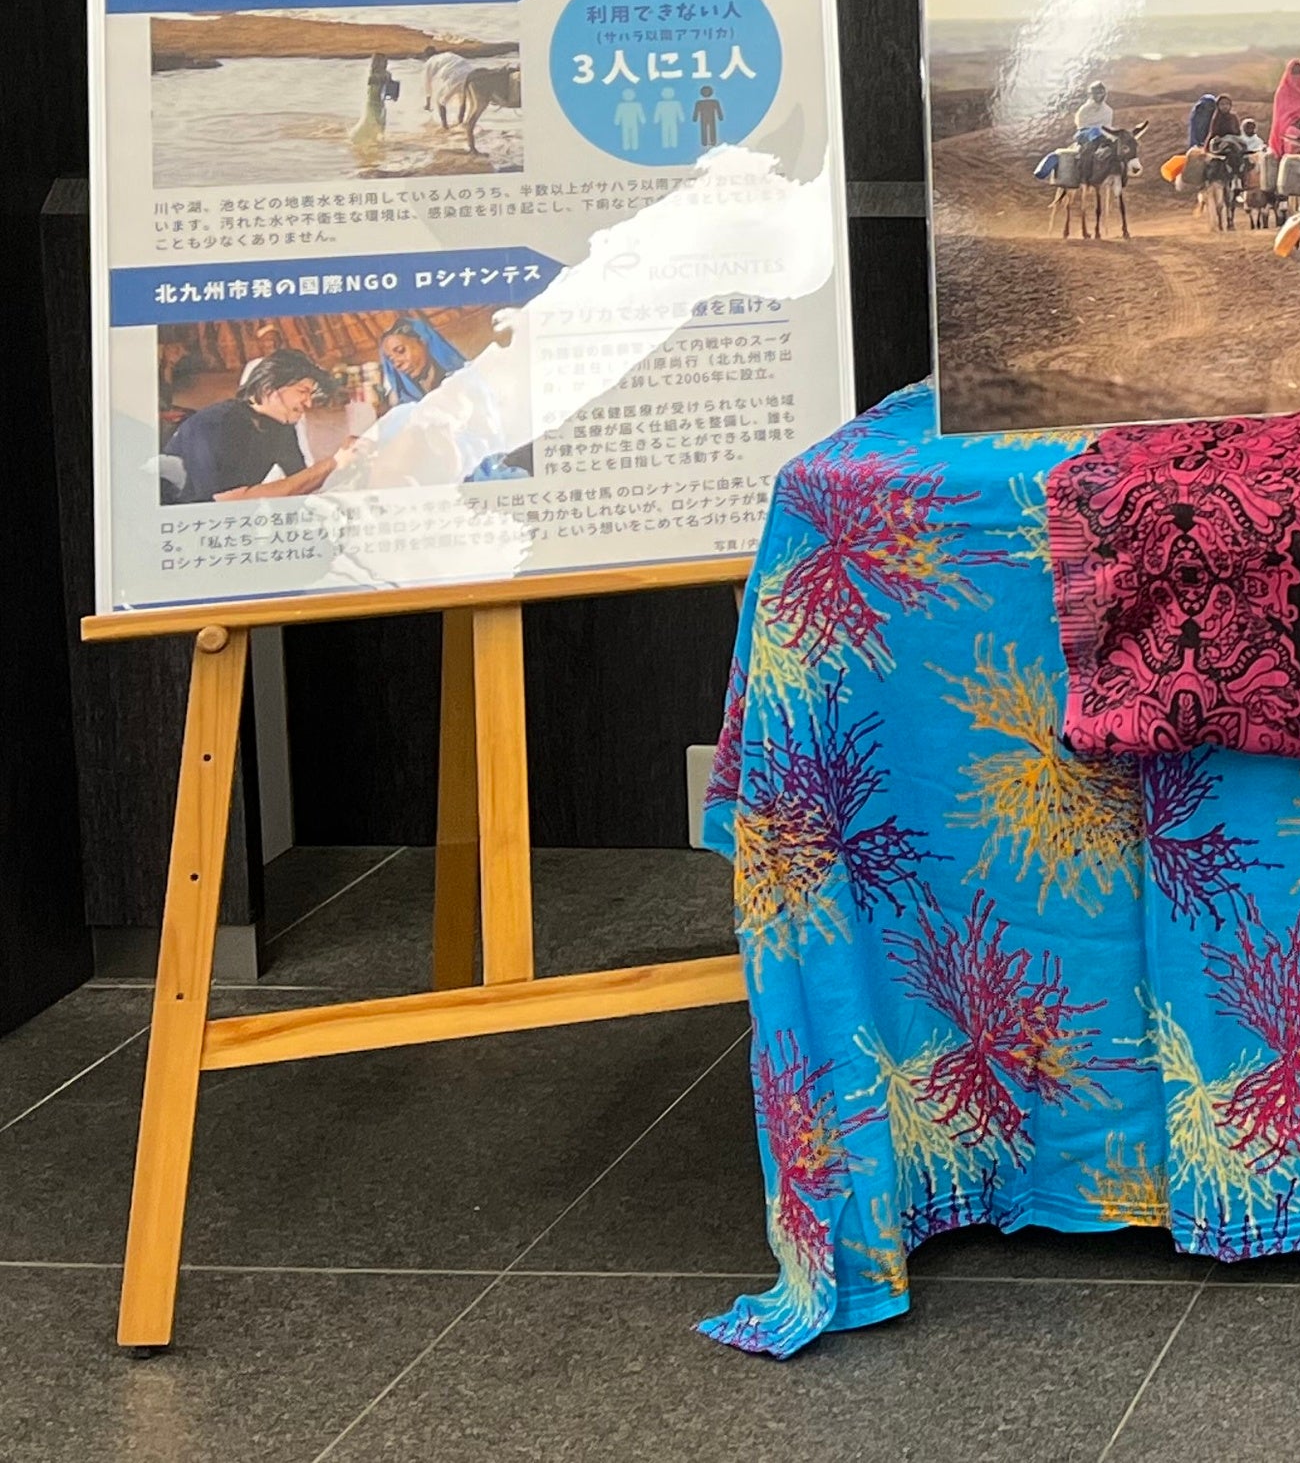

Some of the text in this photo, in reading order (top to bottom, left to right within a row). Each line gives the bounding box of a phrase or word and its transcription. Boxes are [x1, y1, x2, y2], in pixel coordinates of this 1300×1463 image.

[587, 1, 742, 24] 利用できない人
[572, 45, 757, 85] 3人に1人
[155, 231, 337, 251] ことも少なくありません。
[155, 265, 542, 305] 北九州市発の国際NGO ロシナンテス
[542, 395, 795, 423] 必な保健医療が受けられない地域
[544, 428, 795, 458] が健やかに生きることができる環境を
[544, 449, 744, 475] 作ることを目指して活動する。
